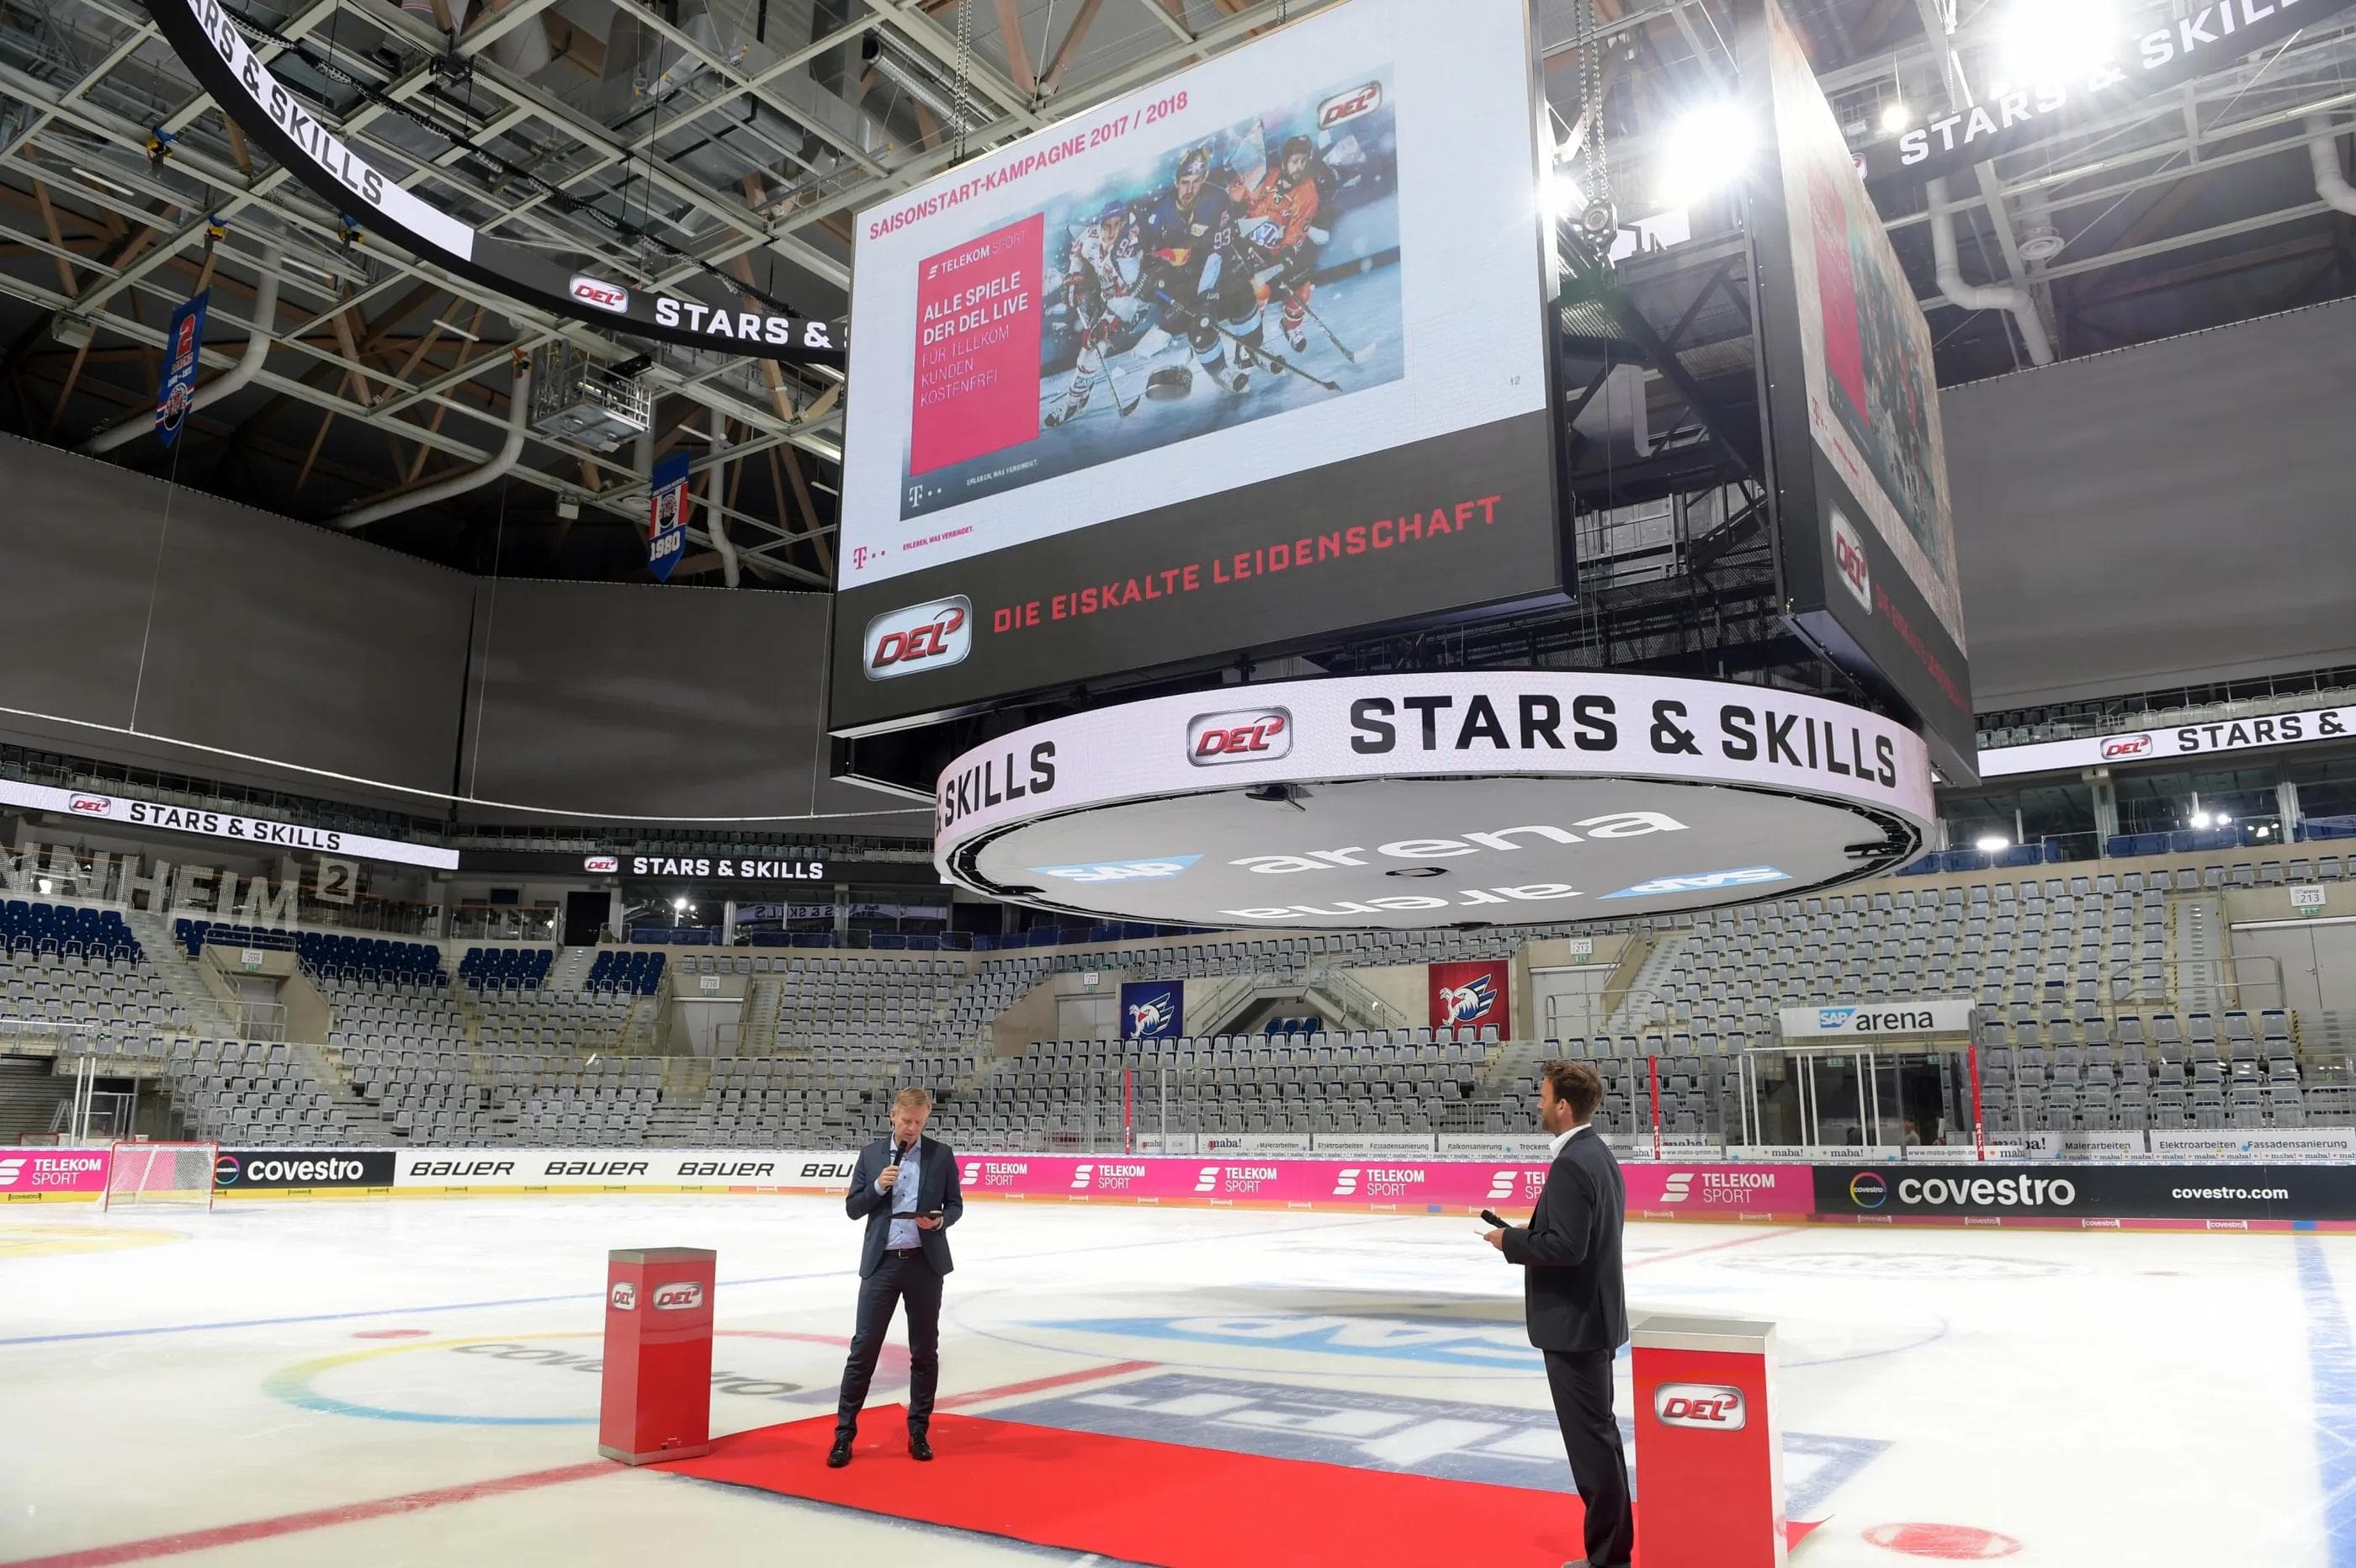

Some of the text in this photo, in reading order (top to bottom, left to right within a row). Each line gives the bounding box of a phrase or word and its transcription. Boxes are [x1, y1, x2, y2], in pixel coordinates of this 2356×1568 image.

[1322, 87, 1378, 126] DEL
[242, 53, 261, 101] &
[269, 85, 383, 205] SKILLS
[869, 90, 1189, 241] SAISONSTART-KAMPAGNE 2017 / 2018
[1214, 228, 1231, 250] 93
[942, 230, 1027, 273] TELEKOM SPORT
[924, 271, 1021, 322] ALLE SPIELE
[574, 284, 624, 306] DEL
[655, 297, 789, 345] STARS
[804, 321, 833, 349] &
[924, 292, 1028, 346] DER DEL LIVE
[921, 358, 974, 387] KUNDEN
[1510, 375, 1520, 385] 12
[650, 531, 681, 562] 1980
[929, 534, 941, 543] WAS
[872, 495, 1501, 668] DEL DIE EISKALTE LEIDENSCHAFT
[1195, 694, 1897, 788] DEL STARS & SKILLS
[2106, 711, 2348, 755] DEL STARS &
[945, 740, 1056, 828] SKILLS
[72, 800, 341, 851] DEL STARS & SKILLS
[1047, 811, 1691, 882] SAP arena
[587, 857, 824, 879] DEL STARS & SKILLS
[1217, 867, 1782, 919] SAP arena
[2300, 893, 2320, 903] 213
[1820, 1010, 1934, 1031] SAP arena
[1771, 1149, 1803, 1157] maba!
[2066, 1141, 2131, 1151] Malerarbeiten
[2160, 1139, 2348, 1151] Elektroarbeiten Fassadensanierung
[1831, 1149, 1864, 1158] maba!
[34, 1158, 102, 1172] TELEKOM
[247, 1157, 363, 1181] covestro
[409, 1162, 516, 1176] BAUER
[544, 1162, 650, 1175] BAUER
[677, 1162, 775, 1176] BAUER
[985, 1163, 1027, 1174] TELEKOM
[1098, 1165, 1145, 1177] TELEKOM
[32, 1172, 81, 1185] SPORT
[984, 1174, 1014, 1185] SPORT
[1225, 1168, 1277, 1179] TELEKOM
[1366, 1169, 1425, 1183] TELEKOM
[1701, 1173, 1775, 1188] TELEKOM
[1098, 1178, 1130, 1189] SPORT
[1225, 1180, 1260, 1194] SPORT
[1366, 1183, 1407, 1196] SPORT
[1898, 1174, 2076, 1206] covestro
[1703, 1189, 1753, 1204] SPORT
[2172, 1186, 2289, 1200] covestro.com
[613, 1289, 634, 1305] DEL
[657, 1286, 700, 1305] DEL
[1662, 1392, 1738, 1422] DEL
